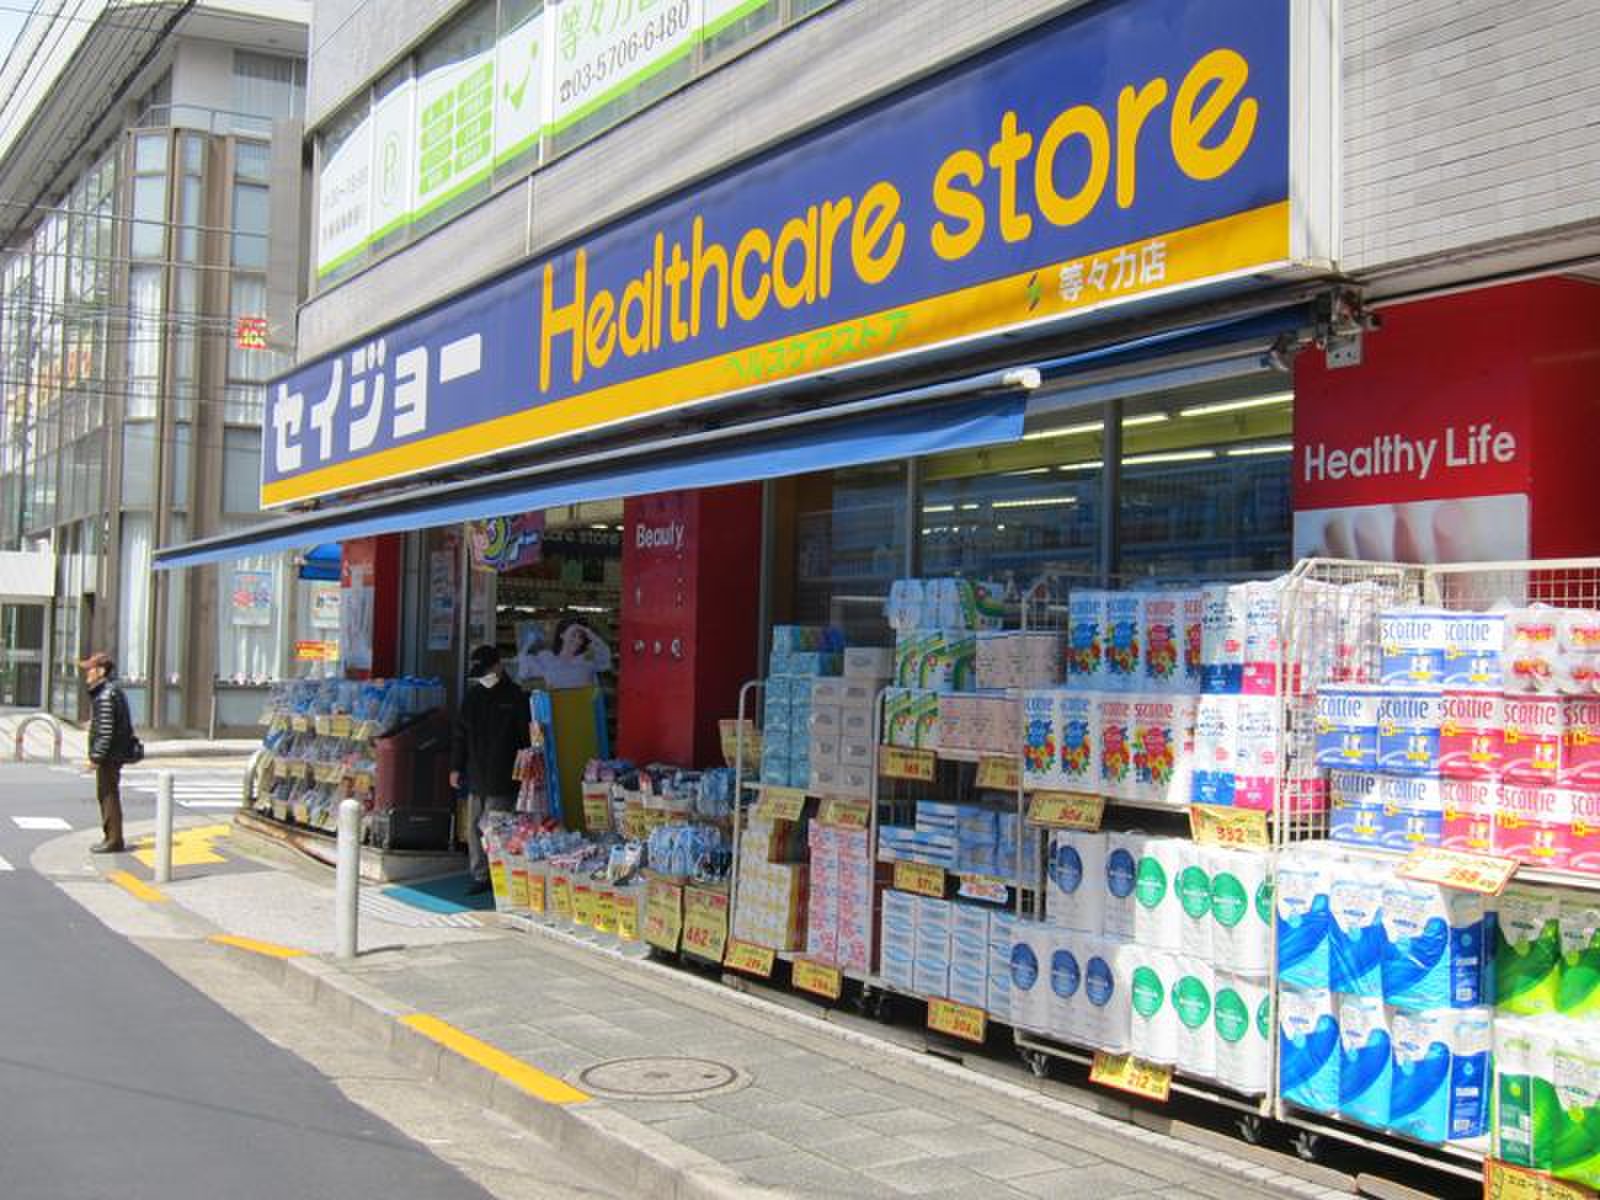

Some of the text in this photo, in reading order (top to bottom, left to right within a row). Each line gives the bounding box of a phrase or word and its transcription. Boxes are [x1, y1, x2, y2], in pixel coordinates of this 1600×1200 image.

[538, 48, 1259, 394] Healthcare store
[1057, 241, 1167, 303] 等々力店
[272, 333, 481, 473] セイジョー
[1304, 423, 1516, 481] Healthy Life
[636, 520, 686, 550] Beauty
